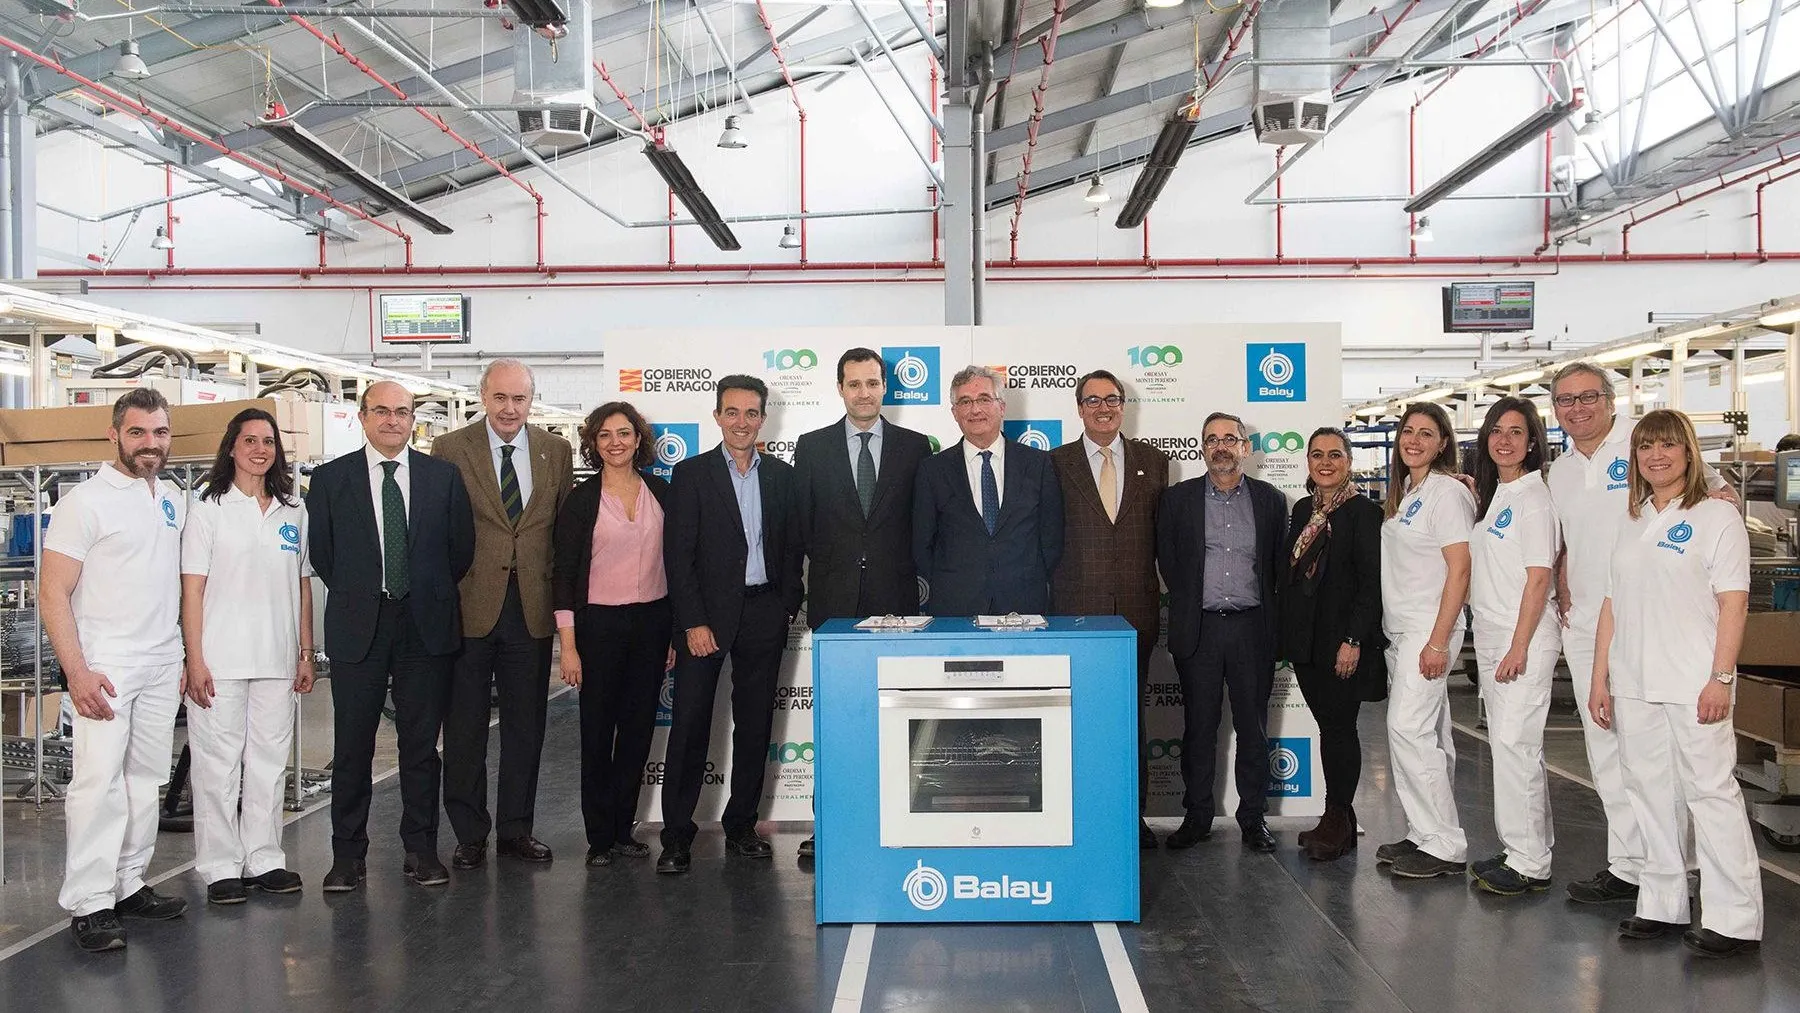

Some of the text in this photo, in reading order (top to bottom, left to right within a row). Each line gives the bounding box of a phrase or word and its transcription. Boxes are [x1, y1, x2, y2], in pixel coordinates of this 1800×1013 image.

[763, 349, 818, 371] 100
[1127, 345, 1183, 367] 100
[643, 368, 712, 380] GOBIERNO
[1008, 365, 1077, 377] GOBIERNO
[644, 381, 662, 392] DE
[1008, 377, 1080, 388] DE ARAGO
[894, 390, 929, 401] Balay
[1259, 387, 1294, 398] Balay
[1131, 437, 1199, 449] BIERNO
[1248, 431, 1305, 454] 100
[653, 467, 673, 476] Bal
[1656, 540, 1686, 554] Balay
[953, 874, 1053, 905] Balay
